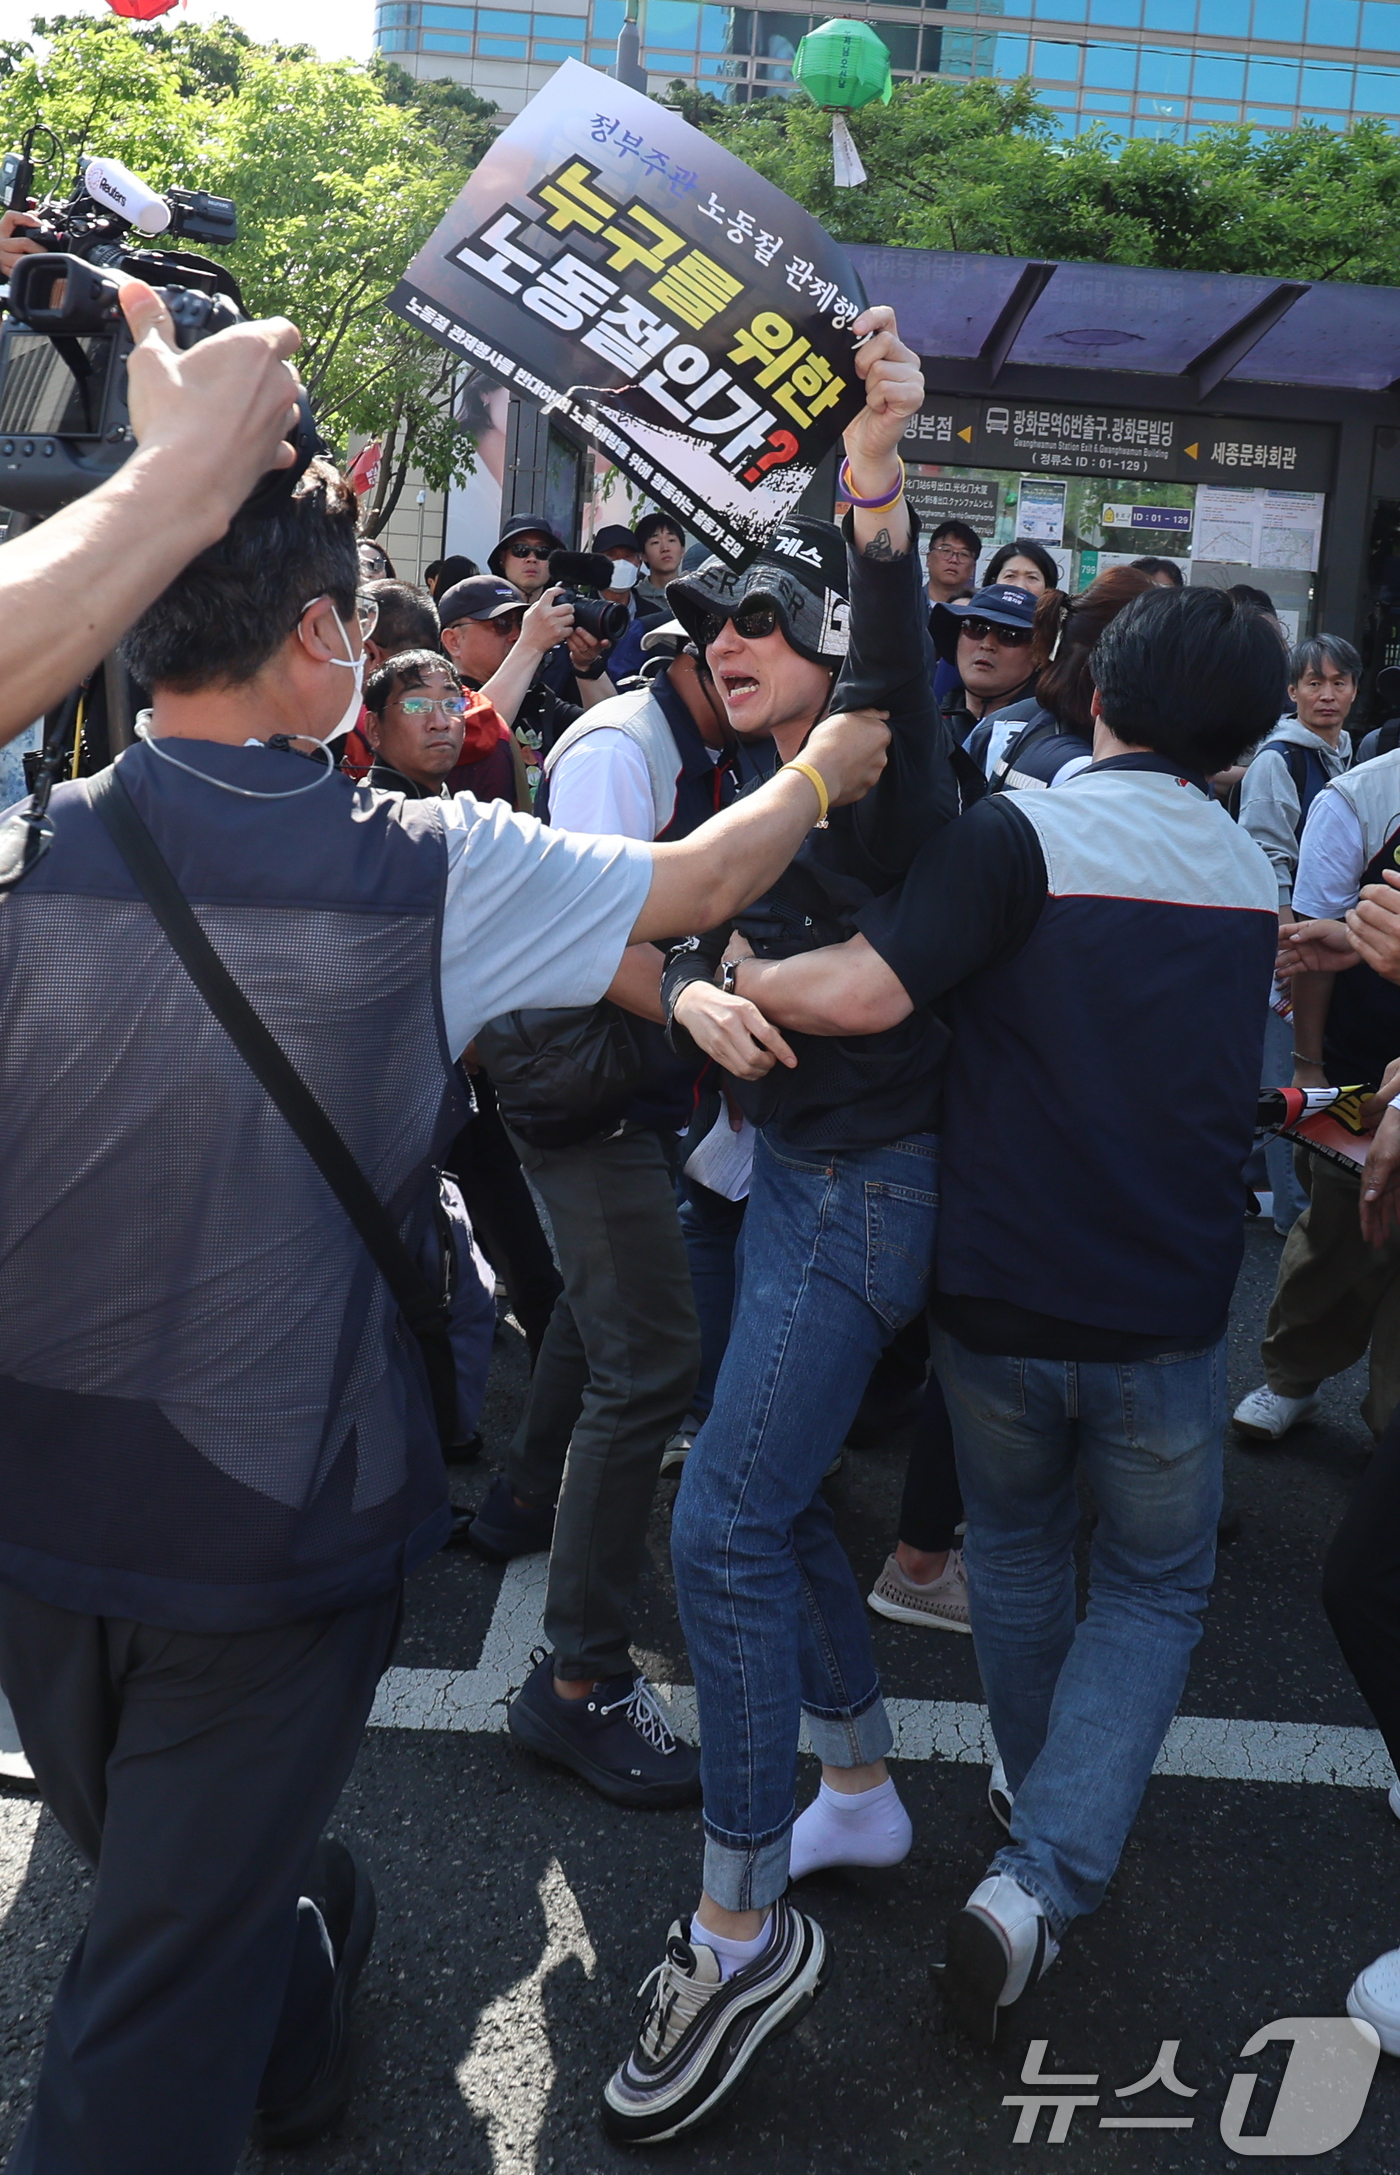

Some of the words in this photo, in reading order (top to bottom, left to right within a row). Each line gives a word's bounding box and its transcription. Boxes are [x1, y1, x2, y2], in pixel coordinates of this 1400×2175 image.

[99, 177, 127, 208] Reuters
[590, 113, 698, 199] 정부주관
[697, 192, 784, 267] 노동절
[537, 161, 745, 331] 누구를
[726, 311, 847, 430] 위한
[456, 212, 799, 484] 노동절인가?
[405, 296, 451, 333] 노동절
[447, 324, 516, 377] 관제행사를
[569, 403, 632, 461] 노동해방을
[628, 452, 655, 481] 위해
[650, 477, 696, 516] 행동하는
[691, 509, 724, 543] 활동가
[720, 534, 745, 559] 모임
[1013, 438, 1057, 450] Gwanghwamun
[1058, 440, 1080, 452] Station
[1081, 442, 1093, 453] Exit
[1143, 448, 1169, 460] Building
[1040, 453, 1072, 467] 정류소
[1075, 456, 1088, 467] ID
[1099, 458, 1140, 471] 01-129
[1210, 441, 1297, 470] 세종문화회관
[1133, 513, 1143, 521] ID
[1081, 565, 1096, 574] 799
